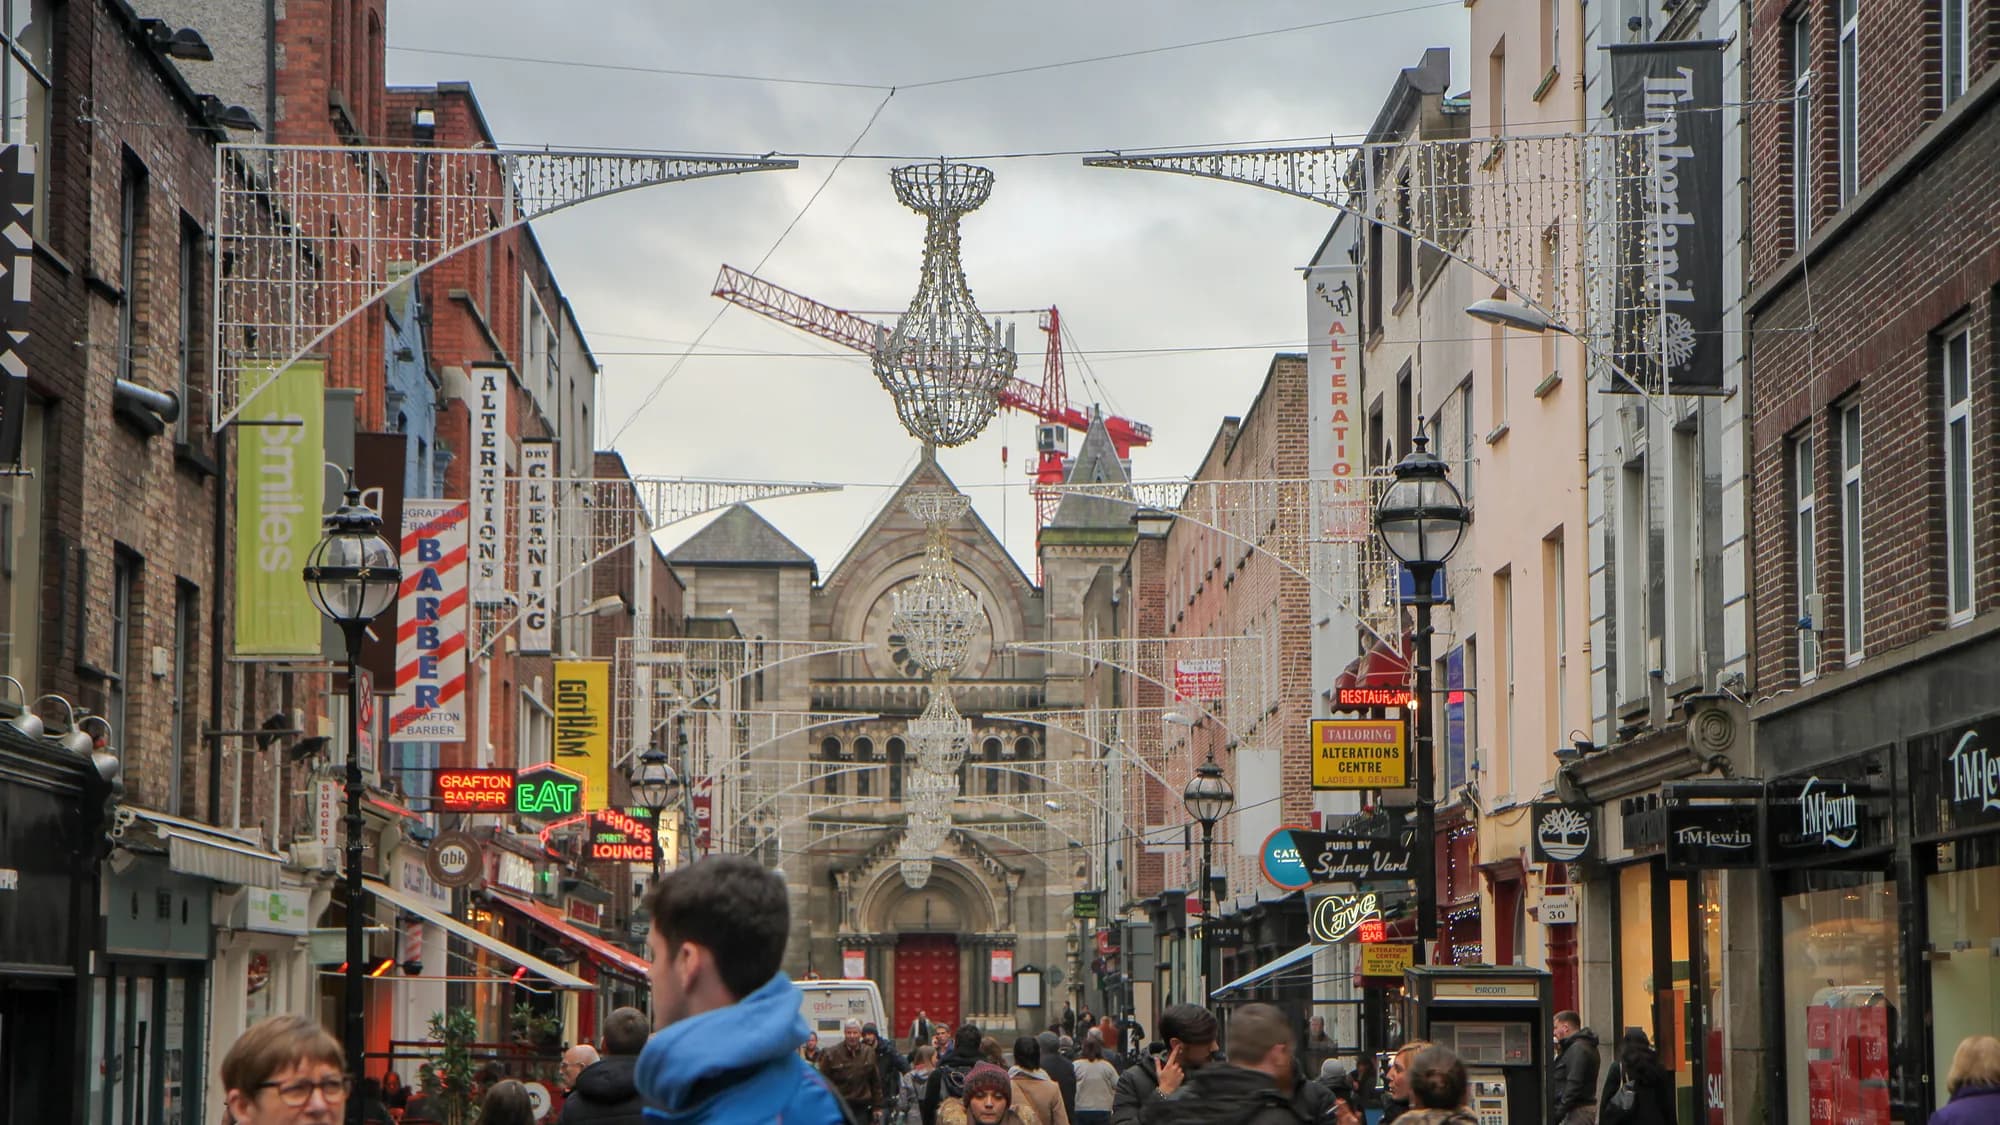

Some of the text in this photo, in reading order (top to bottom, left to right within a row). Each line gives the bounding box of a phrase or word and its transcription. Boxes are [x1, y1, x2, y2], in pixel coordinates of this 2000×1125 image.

[1644, 65, 1695, 302] Timberland
[1328, 320, 1352, 494] ALTERATION
[479, 375, 498, 579] ALTERATIONS
[258, 410, 305, 573] Smiles
[408, 507, 464, 519] GRAFTON
[409, 521, 457, 532] BARBER
[525, 450, 549, 631] DRY CLEANING
[415, 537, 443, 709] BARBER
[405, 712, 461, 721] GRAFTON
[556, 679, 600, 758] GOTHAM
[406, 726, 456, 736] BARBER
[1327, 728, 1392, 741] TAILORING
[1321, 747, 1400, 759] ALTERATIONS
[1338, 761, 1383, 773] CENTRE
[439, 774, 512, 789] GRAFTON
[1321, 775, 1355, 785] LADIES
[1367, 775, 1400, 785] GENTS
[444, 791, 507, 806] BARBER
[517, 780, 578, 813] EAT
[321, 783, 330, 846] SURGERY
[593, 844, 654, 860] LOUNGE
[1325, 840, 1371, 850] FURS BY
[440, 849, 467, 868] gbk
[1312, 851, 1410, 879] Sydney Vard
[1313, 893, 1381, 942] Cave
[1549, 910, 1565, 920] 30
[1360, 923, 1382, 931] WINE
[1361, 932, 1383, 941] BAR
